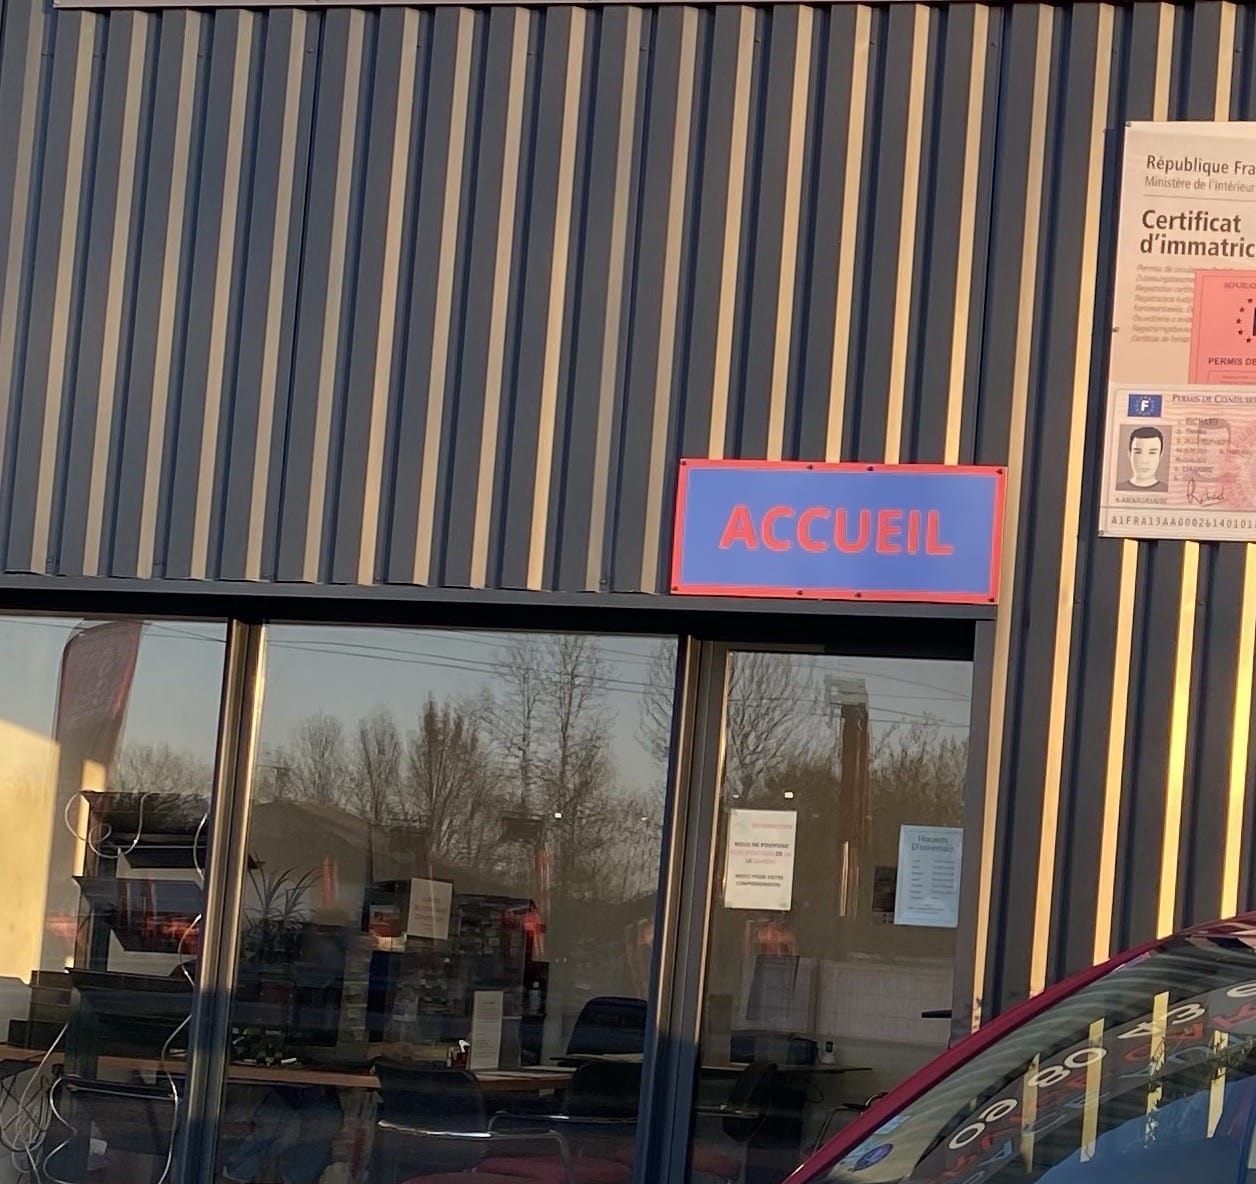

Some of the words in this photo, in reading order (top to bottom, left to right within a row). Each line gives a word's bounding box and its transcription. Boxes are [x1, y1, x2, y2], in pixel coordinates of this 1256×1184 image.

[1146, 154, 1230, 176] République
[1144, 175, 1191, 190] Ministère
[1194, 178, 1207, 190] de
[1142, 209, 1242, 233] Certificat
[1208, 357, 1244, 367] PERMIS
[1141, 400, 1150, 412] F
[1185, 417, 1219, 426] RICHARD
[718, 504, 954, 556] ACCUEIL
